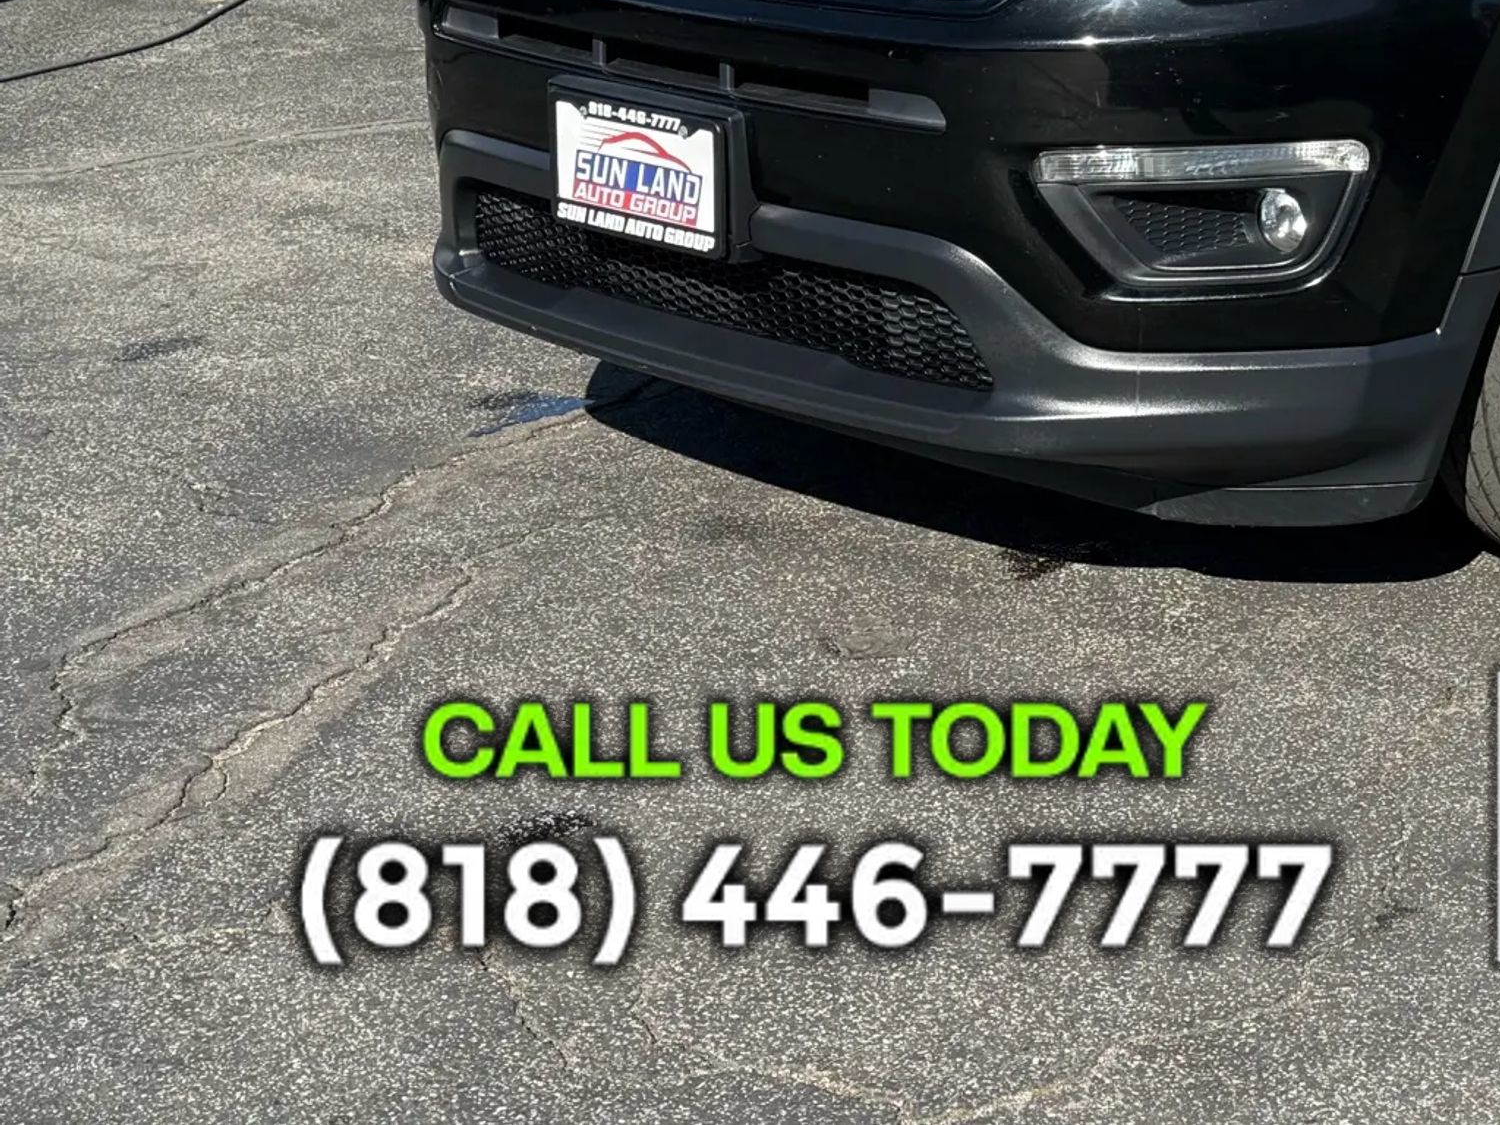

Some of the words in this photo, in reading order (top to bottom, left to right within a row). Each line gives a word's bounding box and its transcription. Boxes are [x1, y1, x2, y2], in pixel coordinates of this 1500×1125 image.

[588, 101, 681, 131] 818-446-7777
[575, 151, 629, 189] SUN
[635, 161, 701, 205] LAND
[573, 181, 625, 207] AUTO
[629, 193, 697, 224] GROUP
[556, 201, 588, 223] SUN
[587, 208, 626, 233] LAND
[624, 218, 665, 242] AUTO
[663, 226, 716, 253] GROUP
